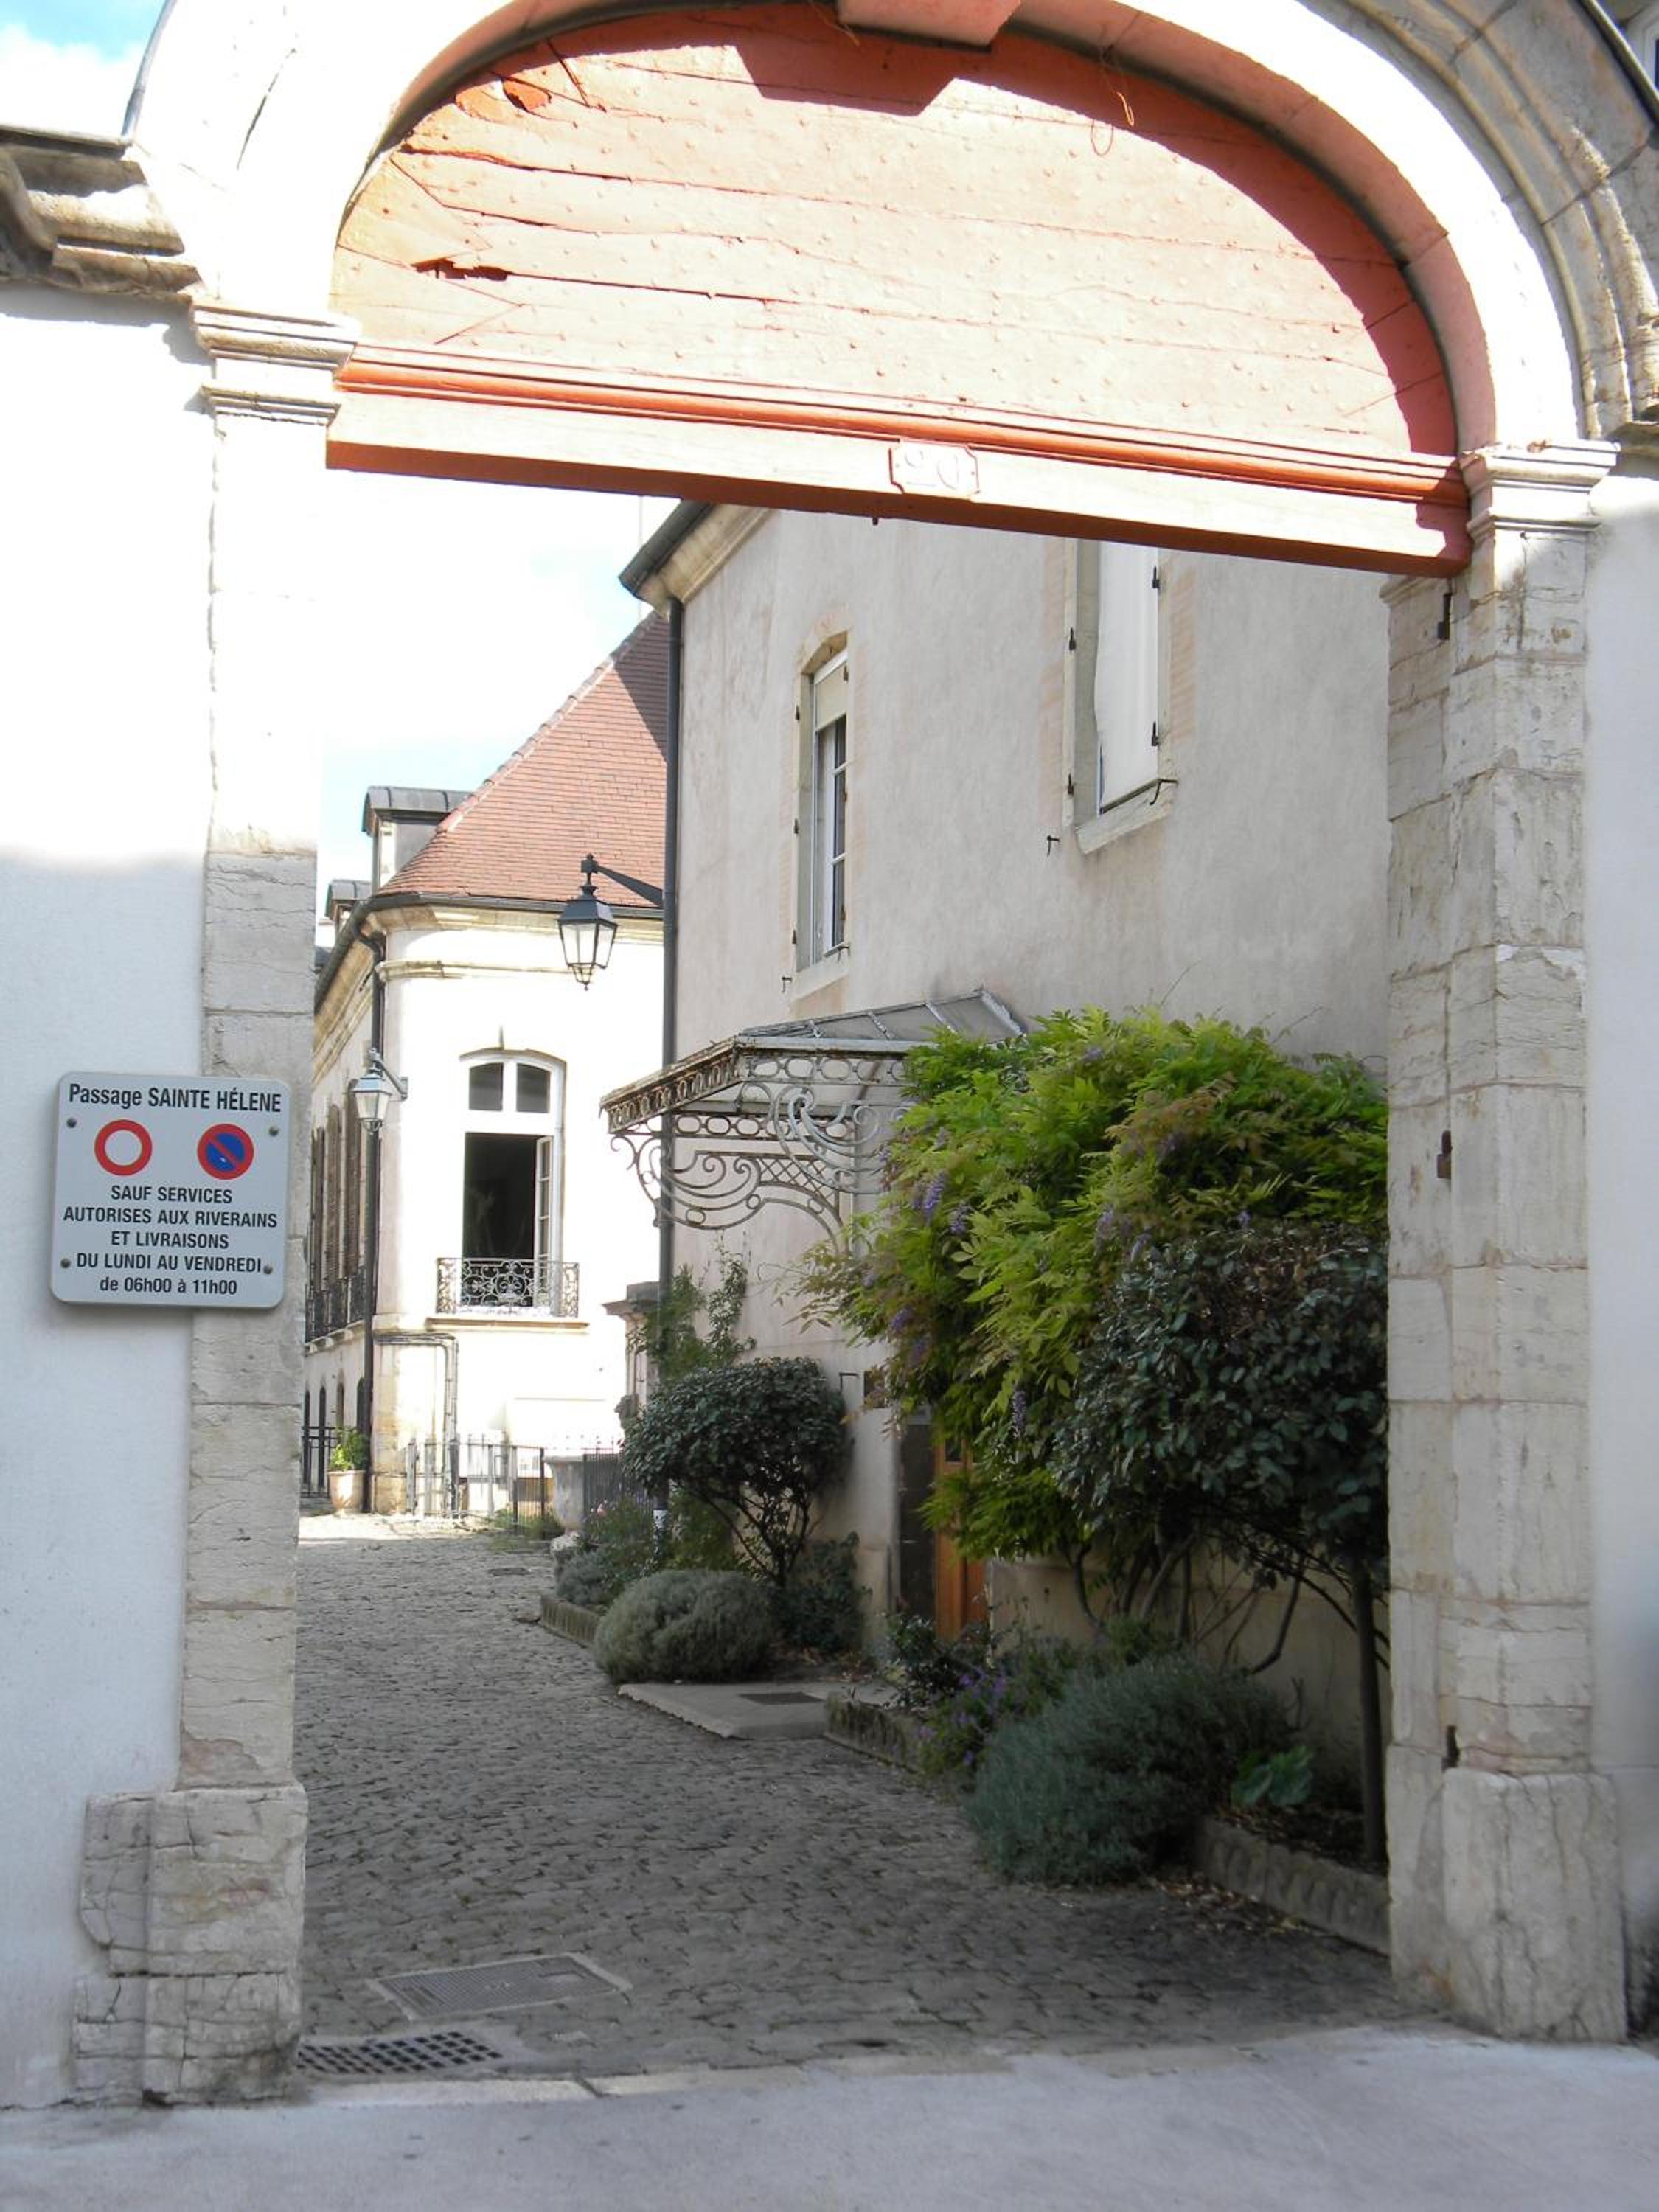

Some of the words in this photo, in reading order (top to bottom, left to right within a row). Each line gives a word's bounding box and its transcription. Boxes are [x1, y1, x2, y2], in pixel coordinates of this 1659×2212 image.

[69, 1083, 142, 1110] Passage
[147, 1087, 211, 1110] SAINTE
[217, 1087, 282, 1113] HÉLENE
[111, 1185, 153, 1201] SAUF
[157, 1186, 233, 1204] SERVICES
[63, 1206, 152, 1224] AUTORISES
[157, 1209, 189, 1225] AUX
[195, 1210, 277, 1228] RIVERAINS
[111, 1231, 131, 1246] ET
[136, 1232, 229, 1249] LIVRAISONS
[76, 1253, 98, 1268] DU
[103, 1254, 151, 1270] LUNDI
[156, 1255, 178, 1270] AU
[184, 1256, 261, 1273] VENDREDI
[100, 1276, 119, 1292] de
[124, 1277, 172, 1293] 06h00
[177, 1279, 187, 1293] à
[193, 1279, 237, 1295] 11h00
